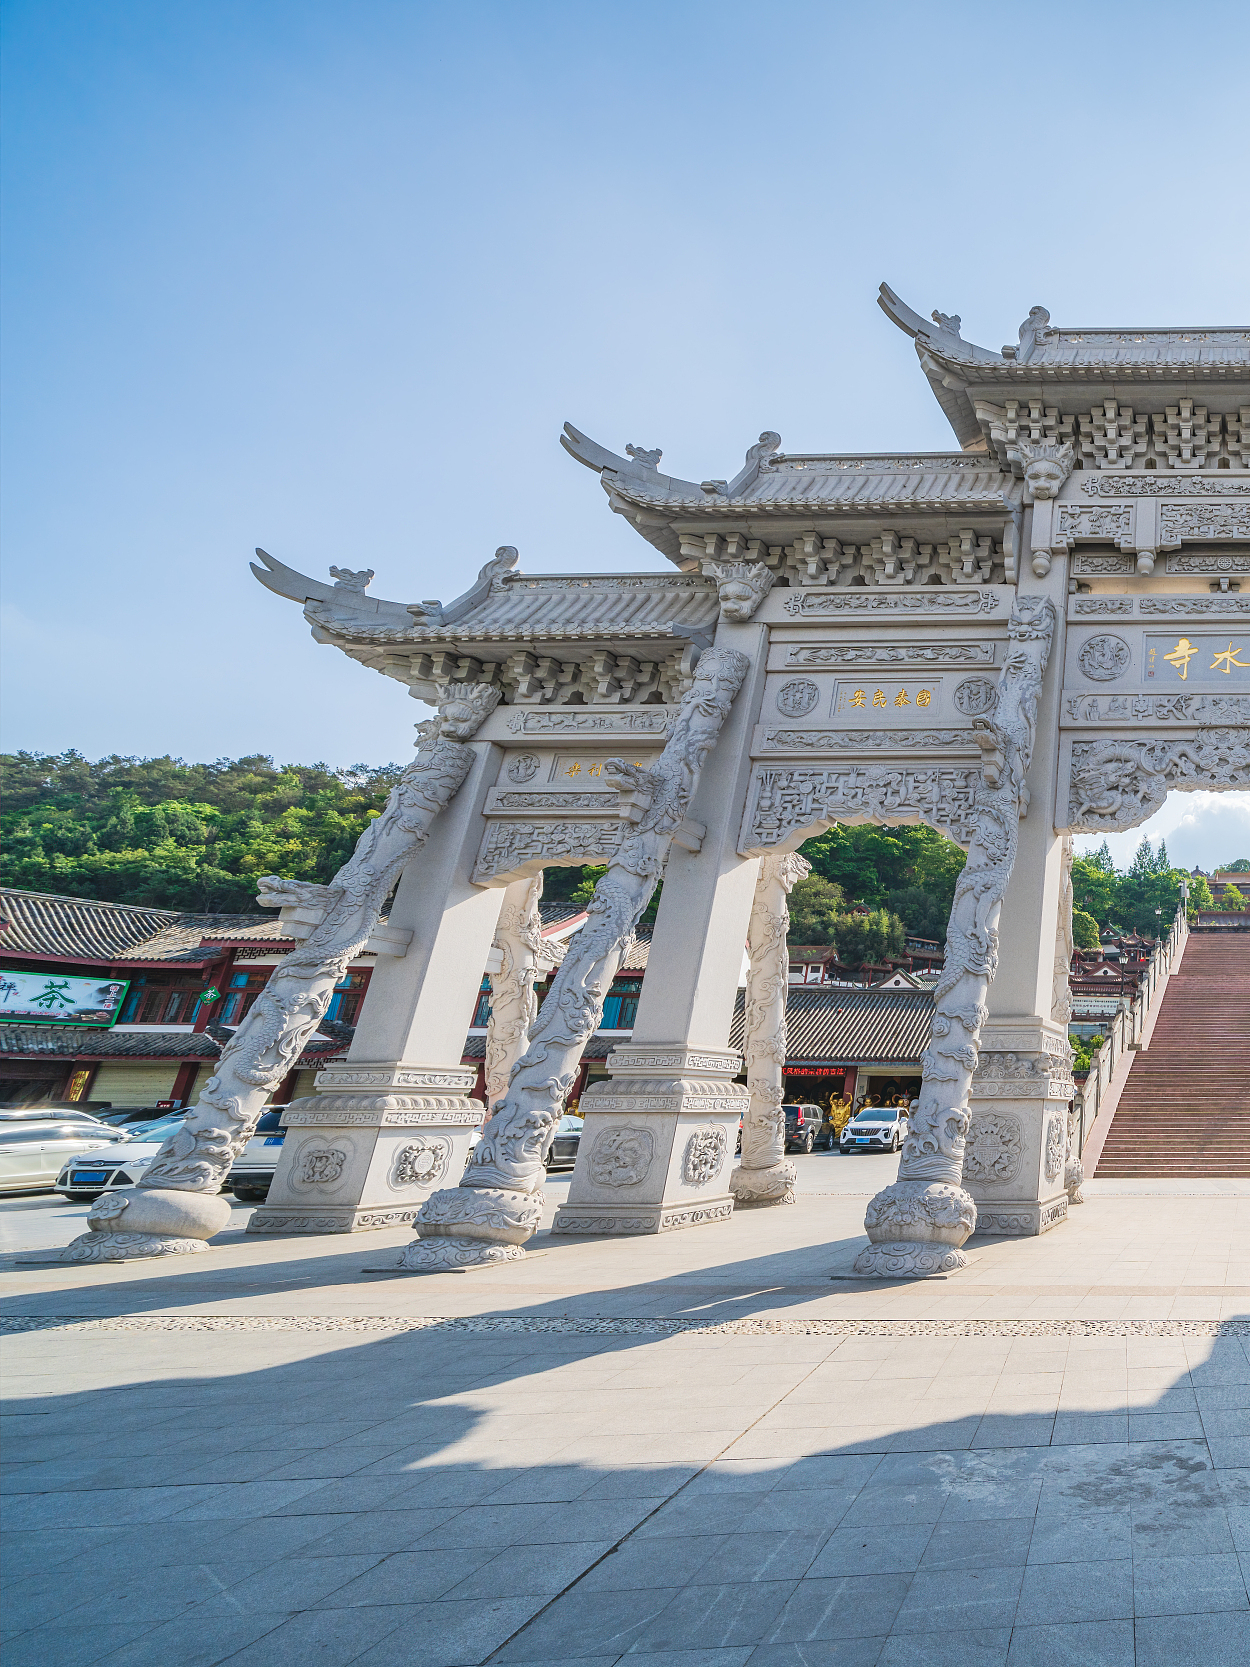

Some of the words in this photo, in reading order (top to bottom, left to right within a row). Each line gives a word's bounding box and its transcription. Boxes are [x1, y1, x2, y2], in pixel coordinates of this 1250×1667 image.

[847, 688, 932, 709] 國泰民安
[28, 978, 77, 1009] 茶
